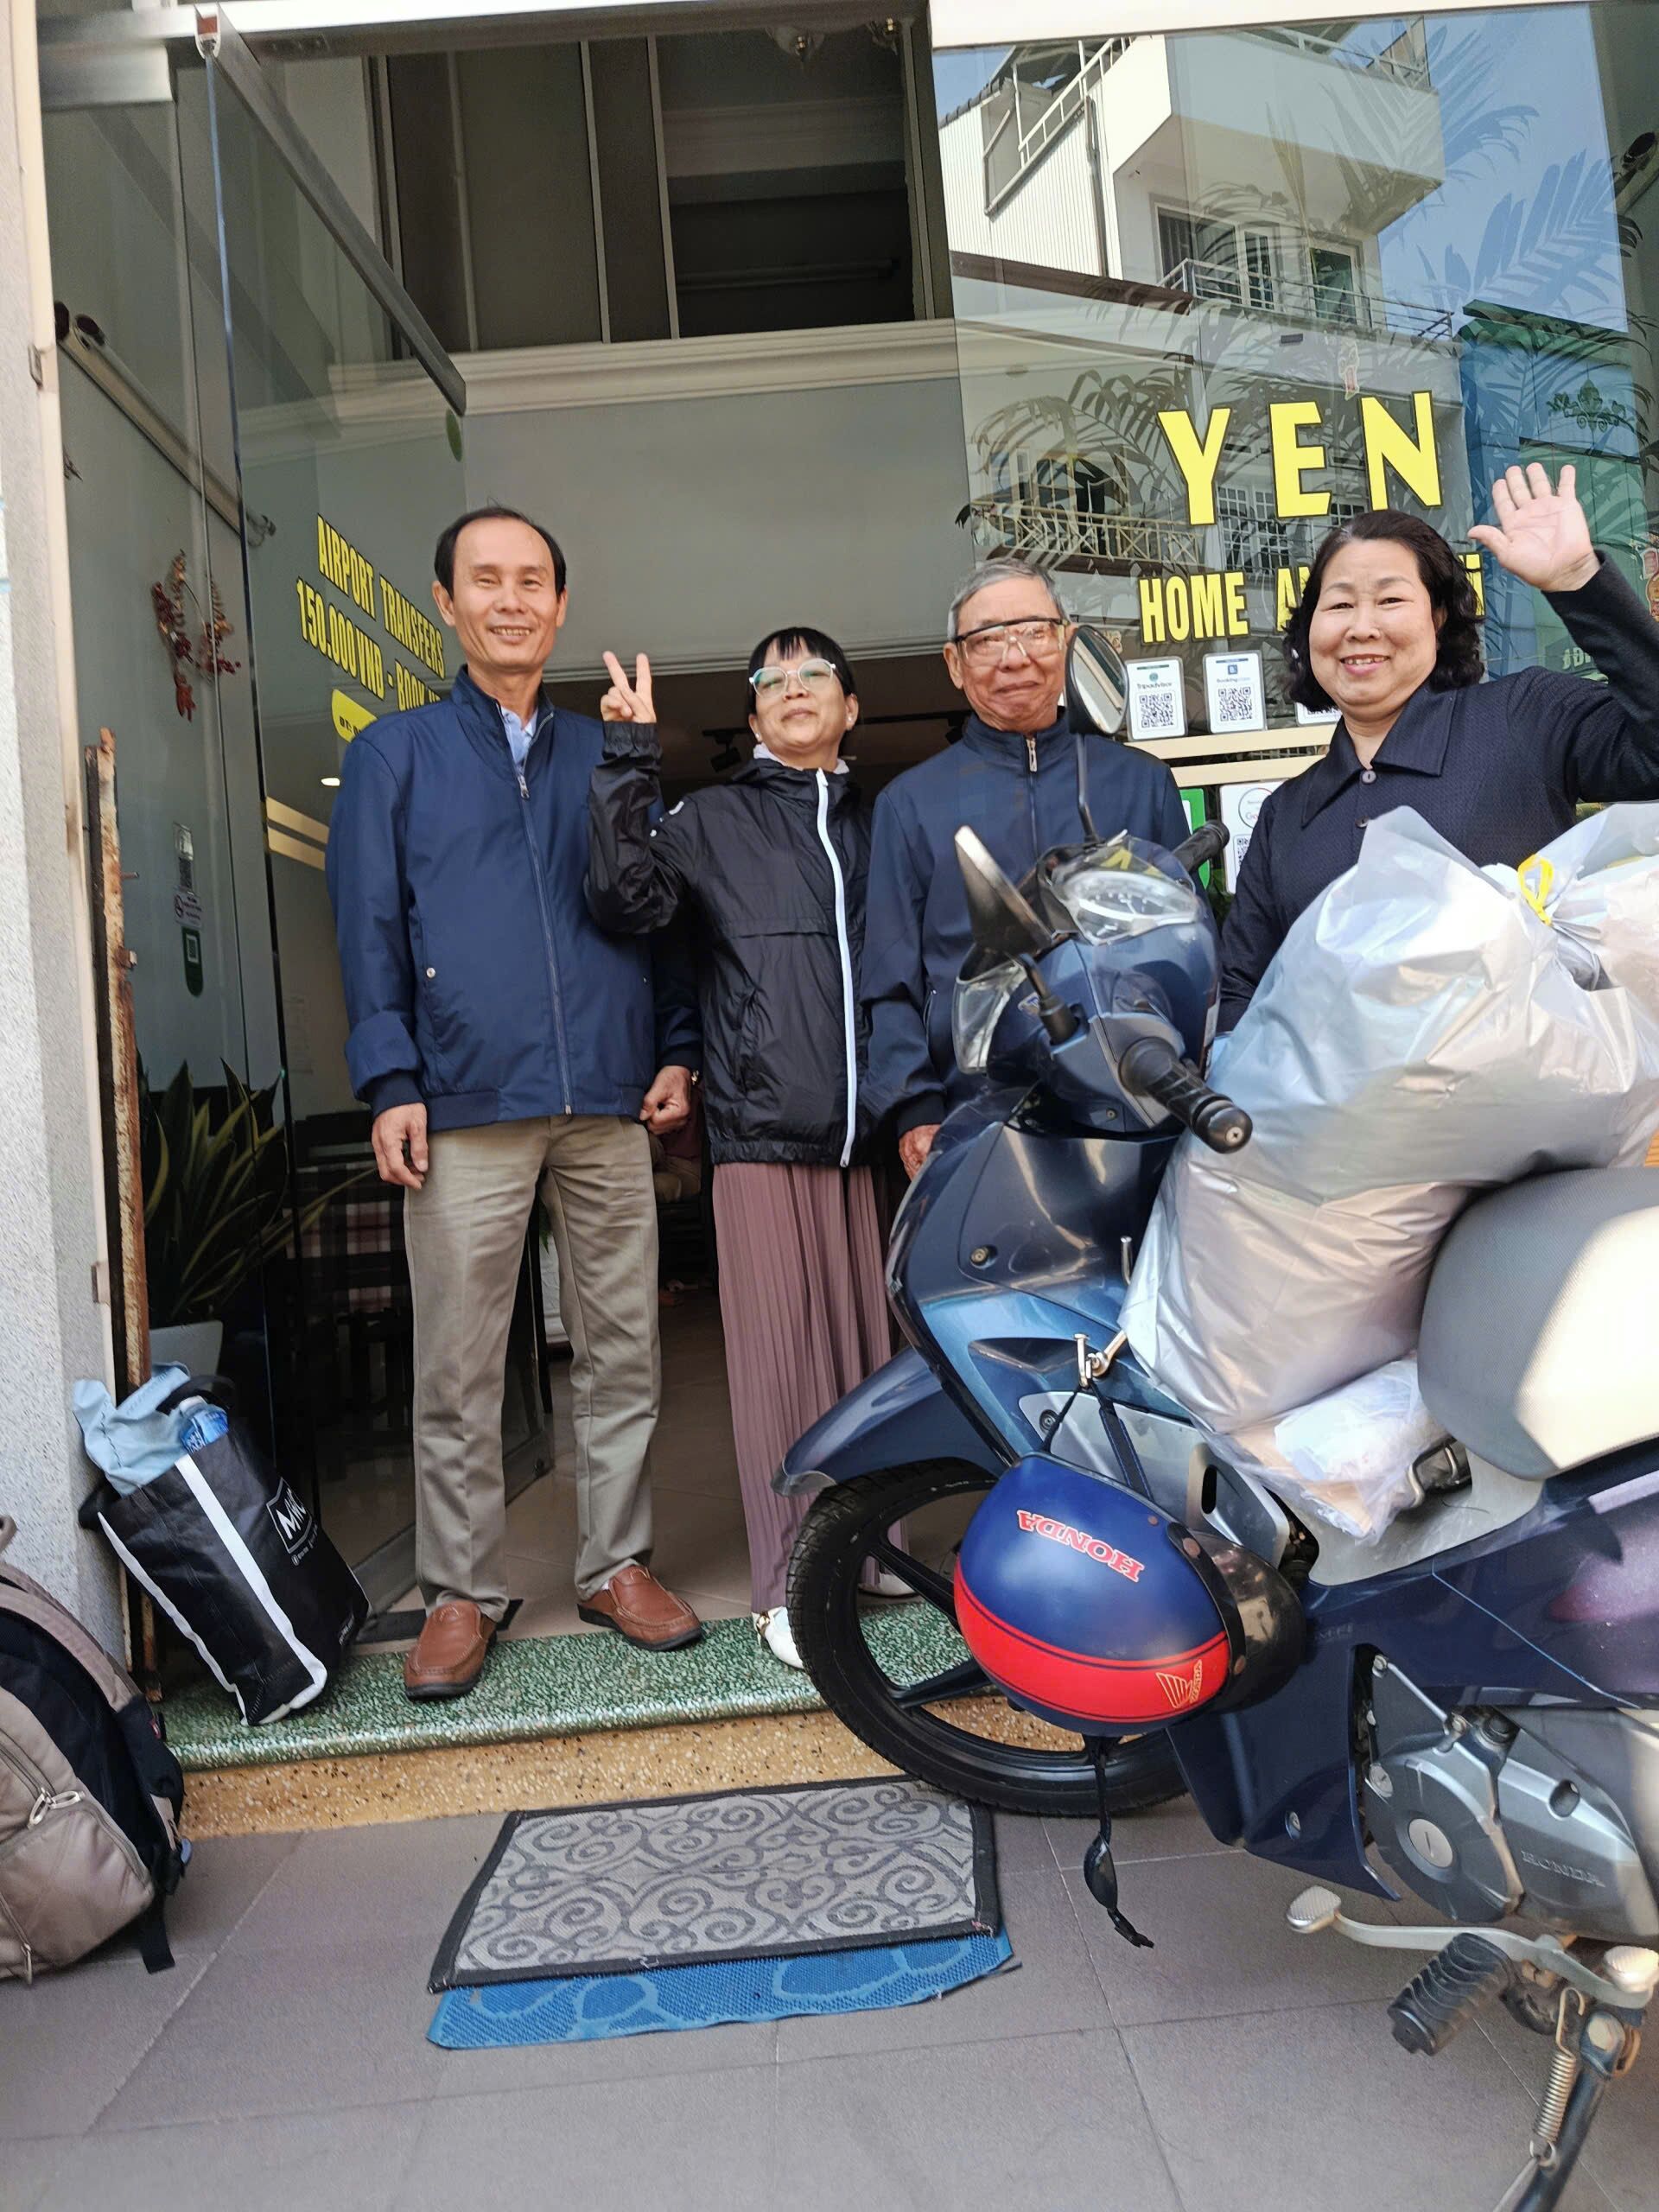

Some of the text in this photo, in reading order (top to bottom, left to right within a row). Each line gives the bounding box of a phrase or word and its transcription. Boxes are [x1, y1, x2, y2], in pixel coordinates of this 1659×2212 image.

[1158, 391, 1441, 525] YEN
[316, 512, 445, 680] AIRPORT TRANSFERS
[1139, 571, 1249, 644] HOME
[1016, 1510, 1145, 1583] HONDA
[1521, 1850, 1606, 1888] HONDA
